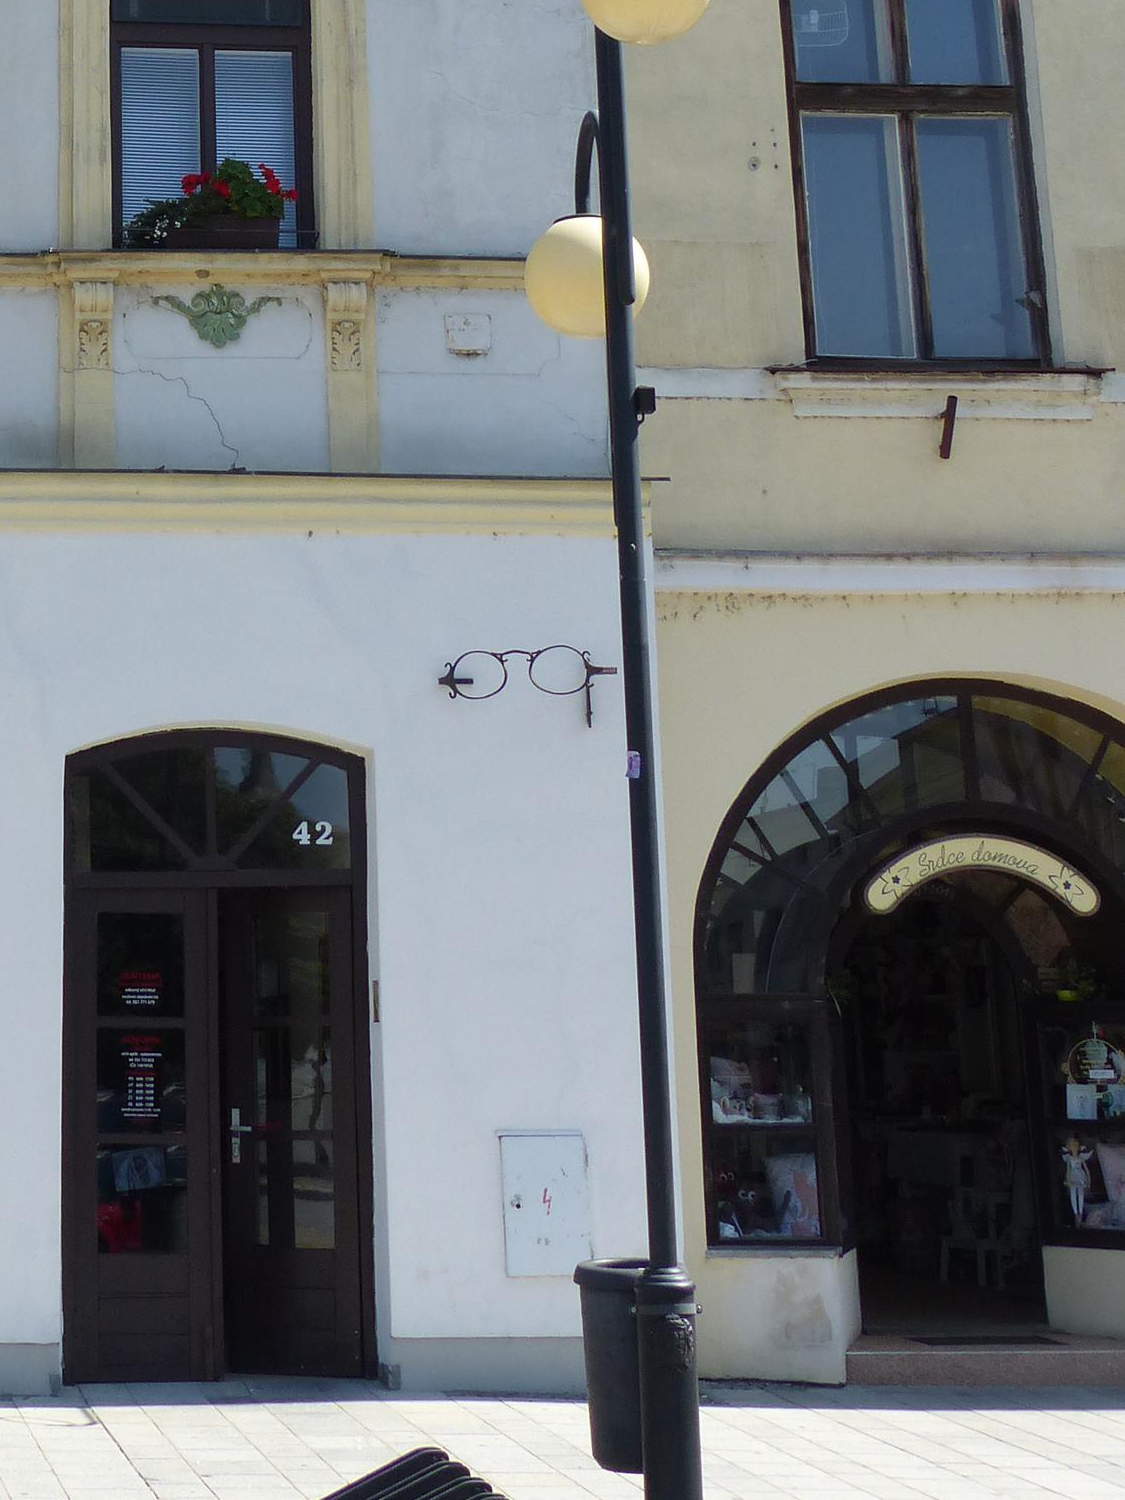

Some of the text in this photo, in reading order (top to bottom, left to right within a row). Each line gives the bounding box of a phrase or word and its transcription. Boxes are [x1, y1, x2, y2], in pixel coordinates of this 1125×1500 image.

[291, 820, 334, 846] 42
[918, 840, 1039, 877] Srdce domova
